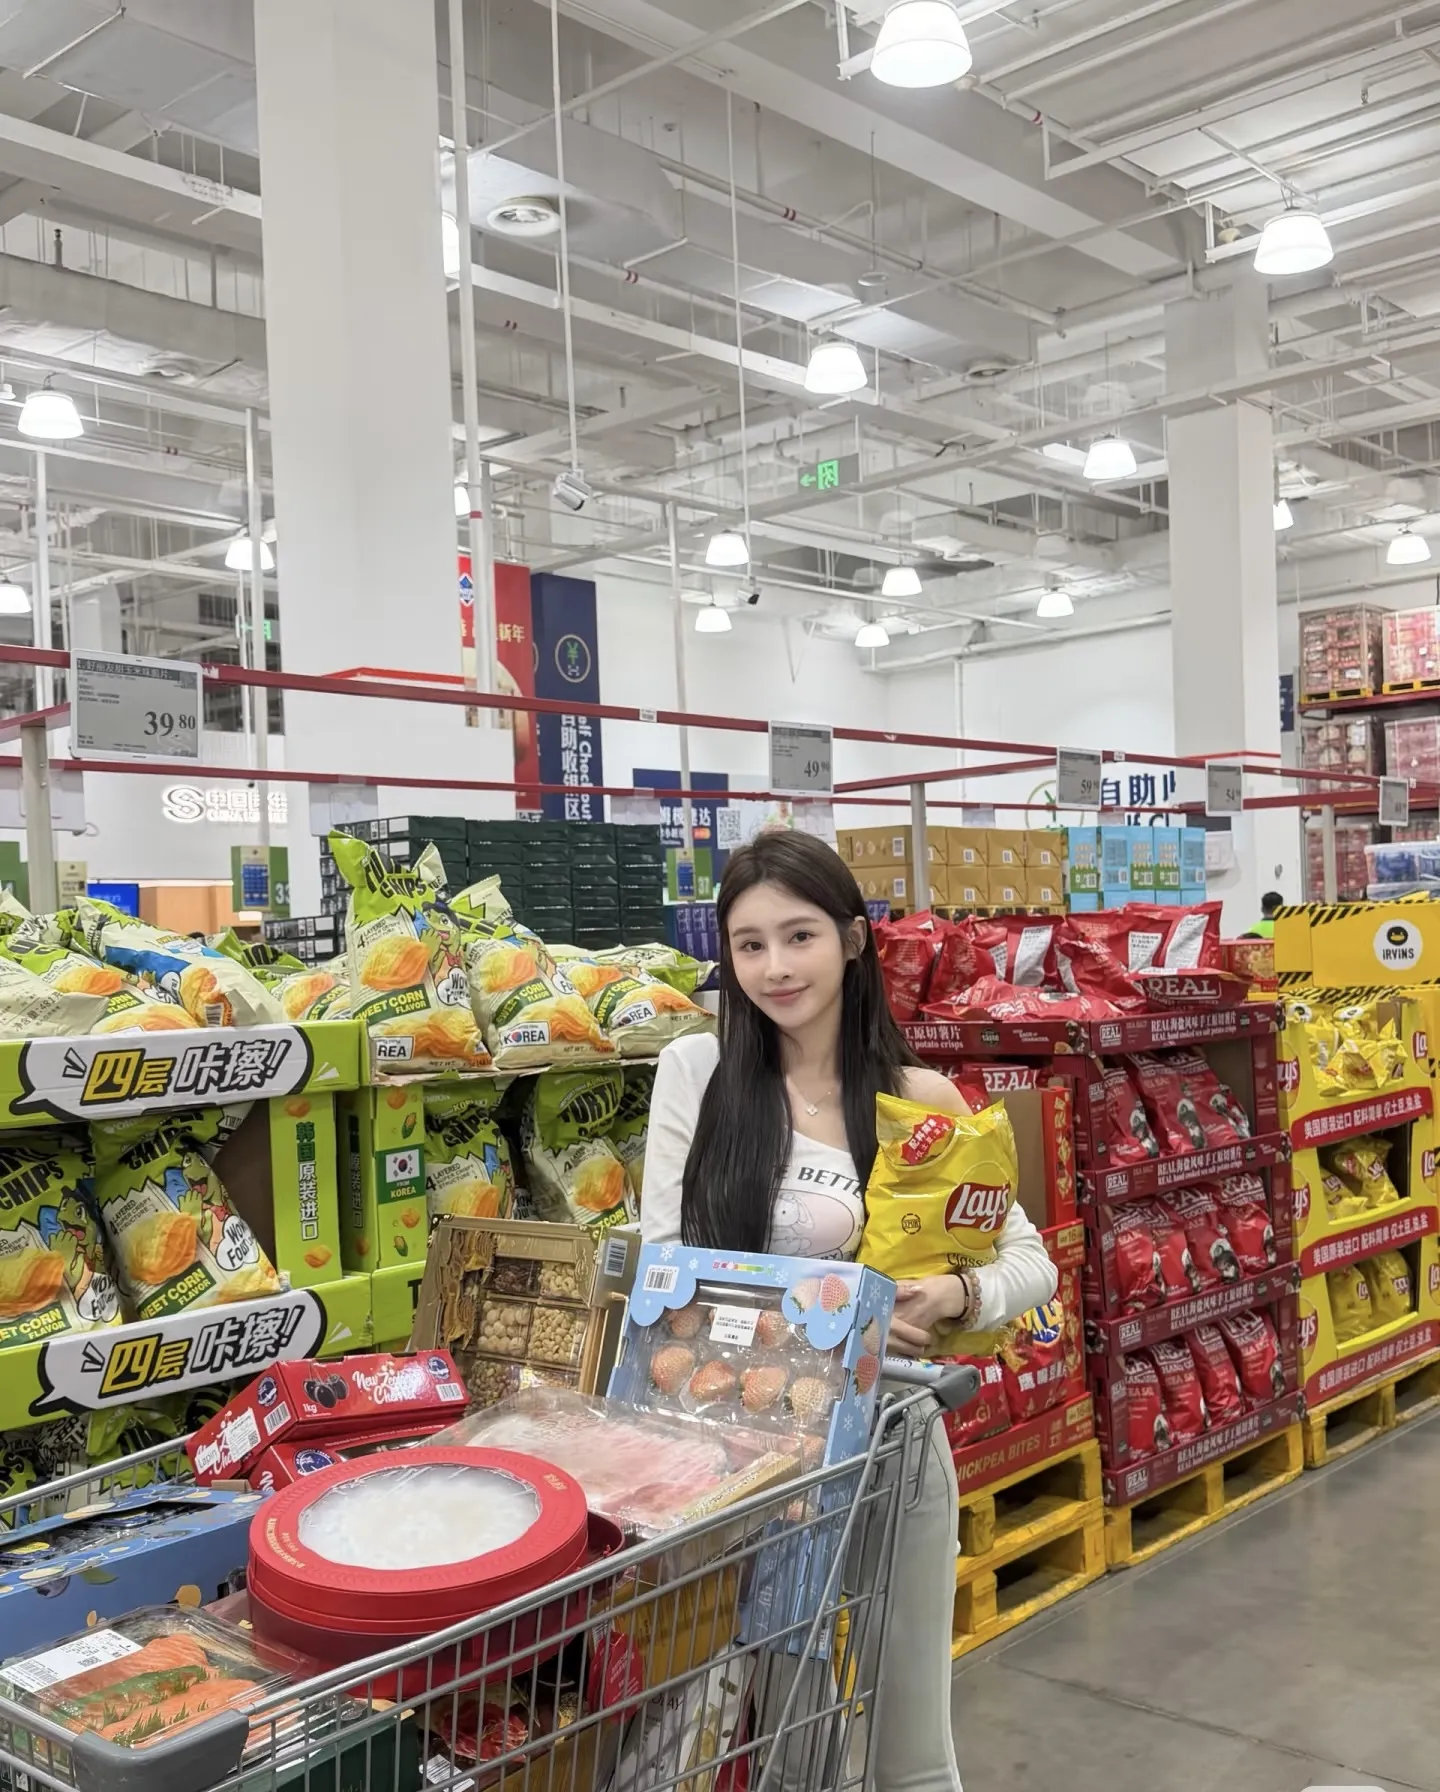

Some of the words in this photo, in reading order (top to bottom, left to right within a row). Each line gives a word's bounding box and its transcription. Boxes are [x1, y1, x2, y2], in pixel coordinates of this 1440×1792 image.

[1148, 977, 1217, 996] REAL
[389, 989, 424, 1008] CORN
[395, 1001, 427, 1015] FLAVOR
[1101, 1026, 1121, 1039] REAL
[915, 1040, 939, 1050] potato
[940, 1040, 964, 1051] crisps
[982, 1071, 1032, 1092] REAL
[0, 1160, 64, 1210] CHIPS
[295, 1121, 320, 1241] 韩国原装进口
[425, 1175, 437, 1191] 4
[1107, 1174, 1128, 1188] REAL
[390, 1186, 417, 1199] KOREA
[948, 1183, 1010, 1233] Lay's
[946, 1252, 989, 1269] Class
[168, 1268, 207, 1301] CORN
[179, 1278, 213, 1307] FLAVOR
[20, 1308, 62, 1334] CORN
[28, 1320, 67, 1341] FLAVOR
[303, 1403, 318, 1414] 1kg
[1008, 1434, 1041, 1456] BITES
[198, 1450, 218, 1471] Lapin
